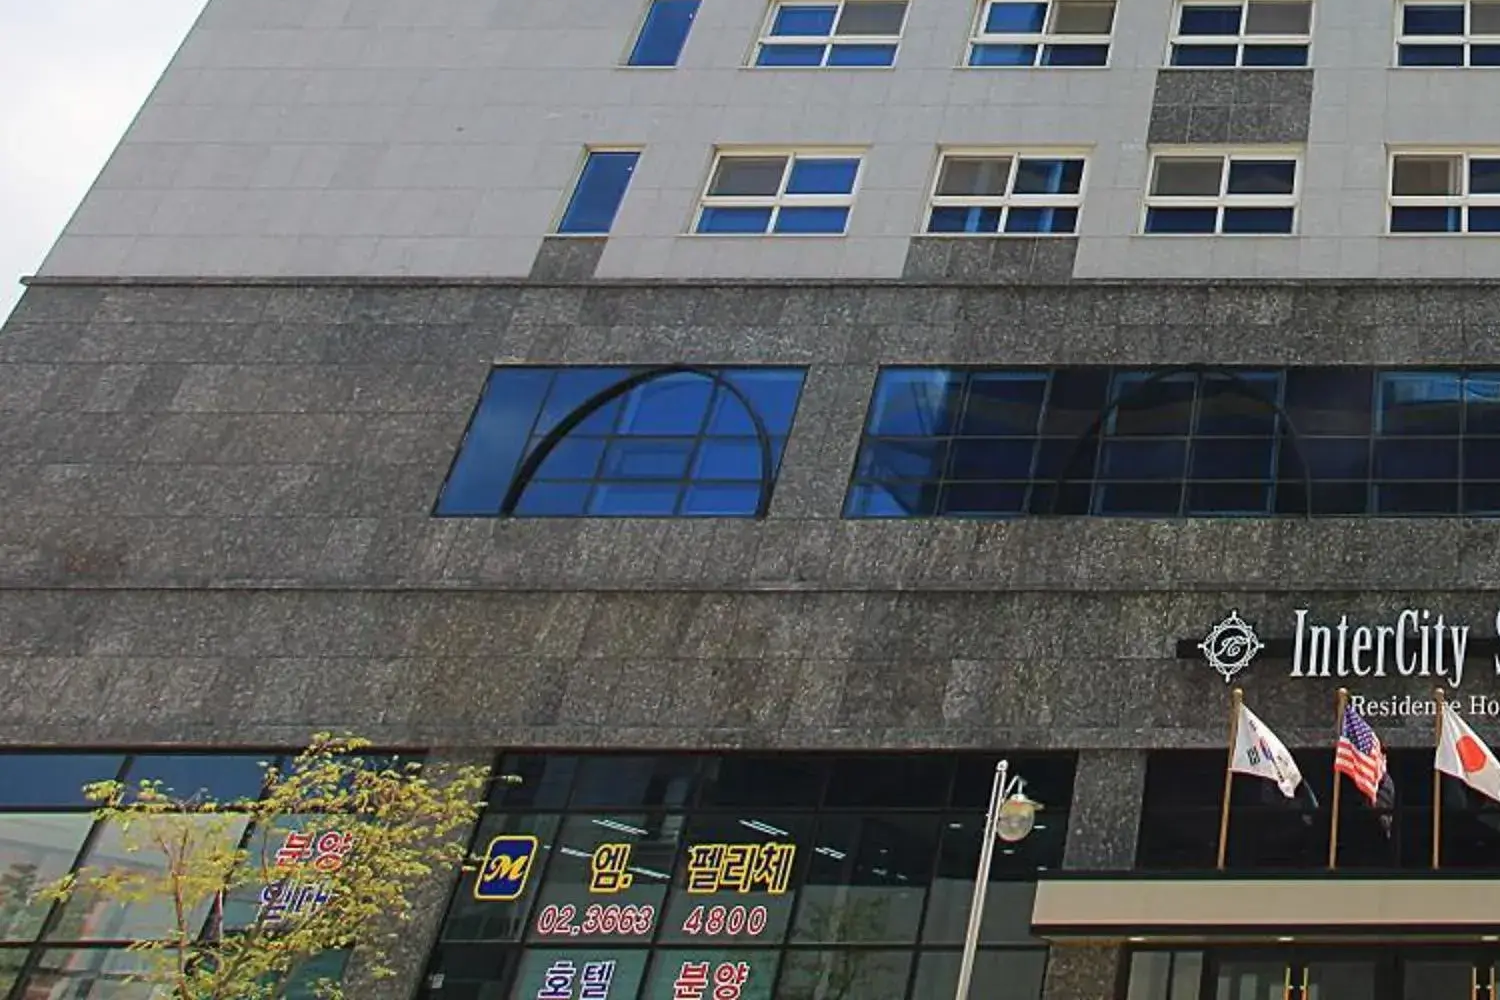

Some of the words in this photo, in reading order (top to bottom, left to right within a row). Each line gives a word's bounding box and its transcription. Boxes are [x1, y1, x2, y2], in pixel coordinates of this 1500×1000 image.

[1289, 609, 1470, 688] InterCity
[682, 905, 767, 936] 4800
[538, 960, 616, 1000] 호텔
[674, 962, 751, 1000] 분양
